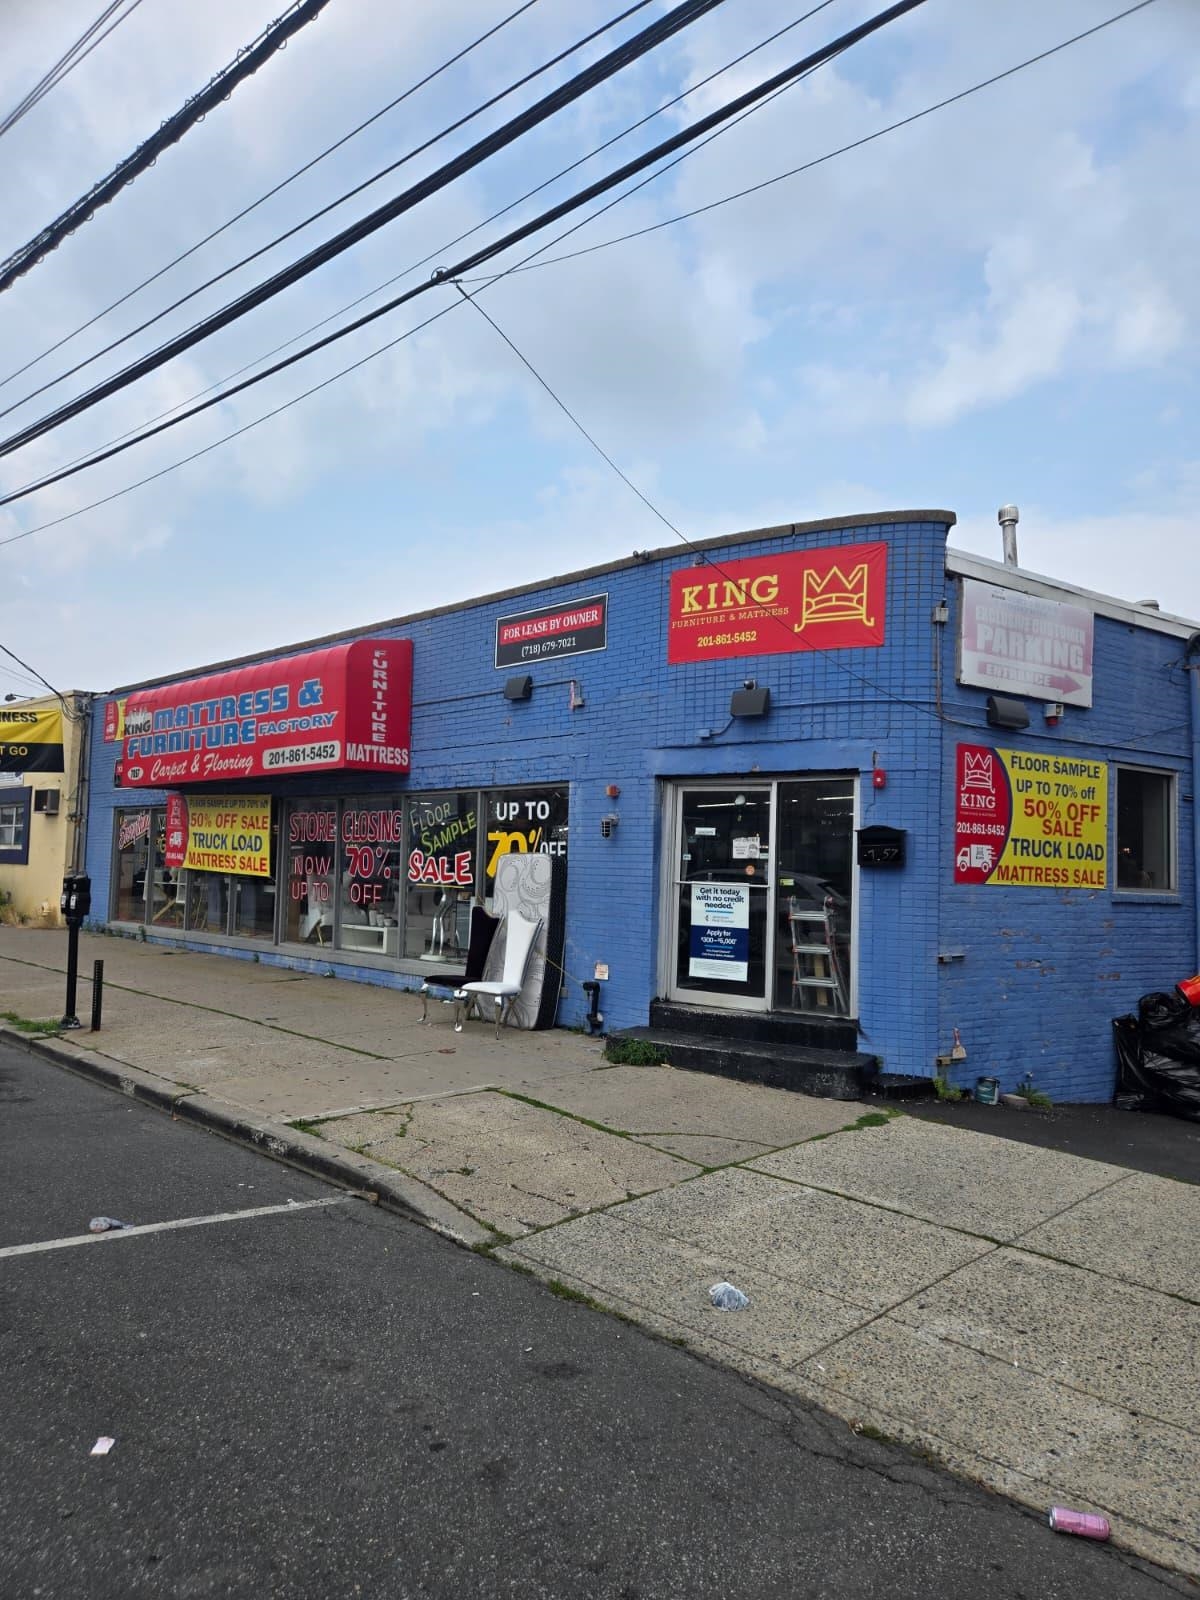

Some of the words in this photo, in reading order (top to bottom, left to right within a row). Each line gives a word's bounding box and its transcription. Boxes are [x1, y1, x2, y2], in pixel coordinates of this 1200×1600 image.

[681, 574, 779, 613] KING
[503, 627, 521, 640] FOR
[522, 621, 549, 636] LEASE
[550, 618, 561, 631] BY
[563, 609, 599, 628] OWNER
[671, 614, 726, 629] FURNITURE
[729, 613, 736, 621] &
[738, 607, 790, 621] MATTRESS
[521, 643, 541, 658] (718)
[541, 636, 577, 652] 679-7021
[697, 630, 758, 647] 201-861-5452
[976, 623, 1084, 673] PARKING
[124, 719, 151, 736] KING
[153, 685, 290, 732] MATTRESS
[298, 679, 325, 708] &
[372, 650, 388, 743] FURNITURE
[127, 718, 257, 759] FURNITURE
[257, 711, 339, 736] FACTORY
[9, 746, 28, 756] GO
[151, 758, 188, 781] Carpet
[191, 753, 200, 773] &
[203, 752, 254, 776] Flooring
[268, 744, 336, 766] 201-861-5452
[346, 742, 409, 767] MATTRESS
[1010, 754, 1050, 774] FLOOR
[1053, 760, 1101, 780] SAMPLE
[1016, 778, 1033, 793] UP
[1036, 781, 1051, 795] TO
[1054, 783, 1078, 799] 70%
[1080, 786, 1096, 800] off
[496, 802, 520, 821] UP
[524, 801, 550, 820] TO
[960, 793, 996, 809] KING
[1023, 798, 1062, 820] 50%
[1067, 802, 1101, 823] OFF
[190, 812, 212, 829] 50%
[215, 813, 238, 828] OFF
[241, 815, 269, 831] SALE
[289, 811, 337, 842] STORE
[342, 810, 402, 843] CLOSING
[410, 802, 451, 834] FLOOR
[956, 821, 1005, 836] 201-861-5452
[1042, 819, 1083, 838] SALE
[192, 832, 228, 850] TRUCK
[231, 833, 263, 852] LOAD
[420, 811, 477, 856] SAMPLE
[540, 840, 567, 856] OFF
[1011, 838, 1063, 859] TRUCK
[1067, 842, 1104, 861] LOAD
[188, 851, 237, 871] MATTRESS
[239, 854, 268, 873] SALE
[294, 855, 331, 877] NOW
[345, 846, 391, 879] 70%
[407, 848, 473, 885] SALE
[996, 864, 1069, 884] MATTRESS
[1073, 868, 1105, 886] SALE
[291, 882, 308, 901] UP
[311, 882, 330, 901] TO
[350, 884, 382, 904] OFF
